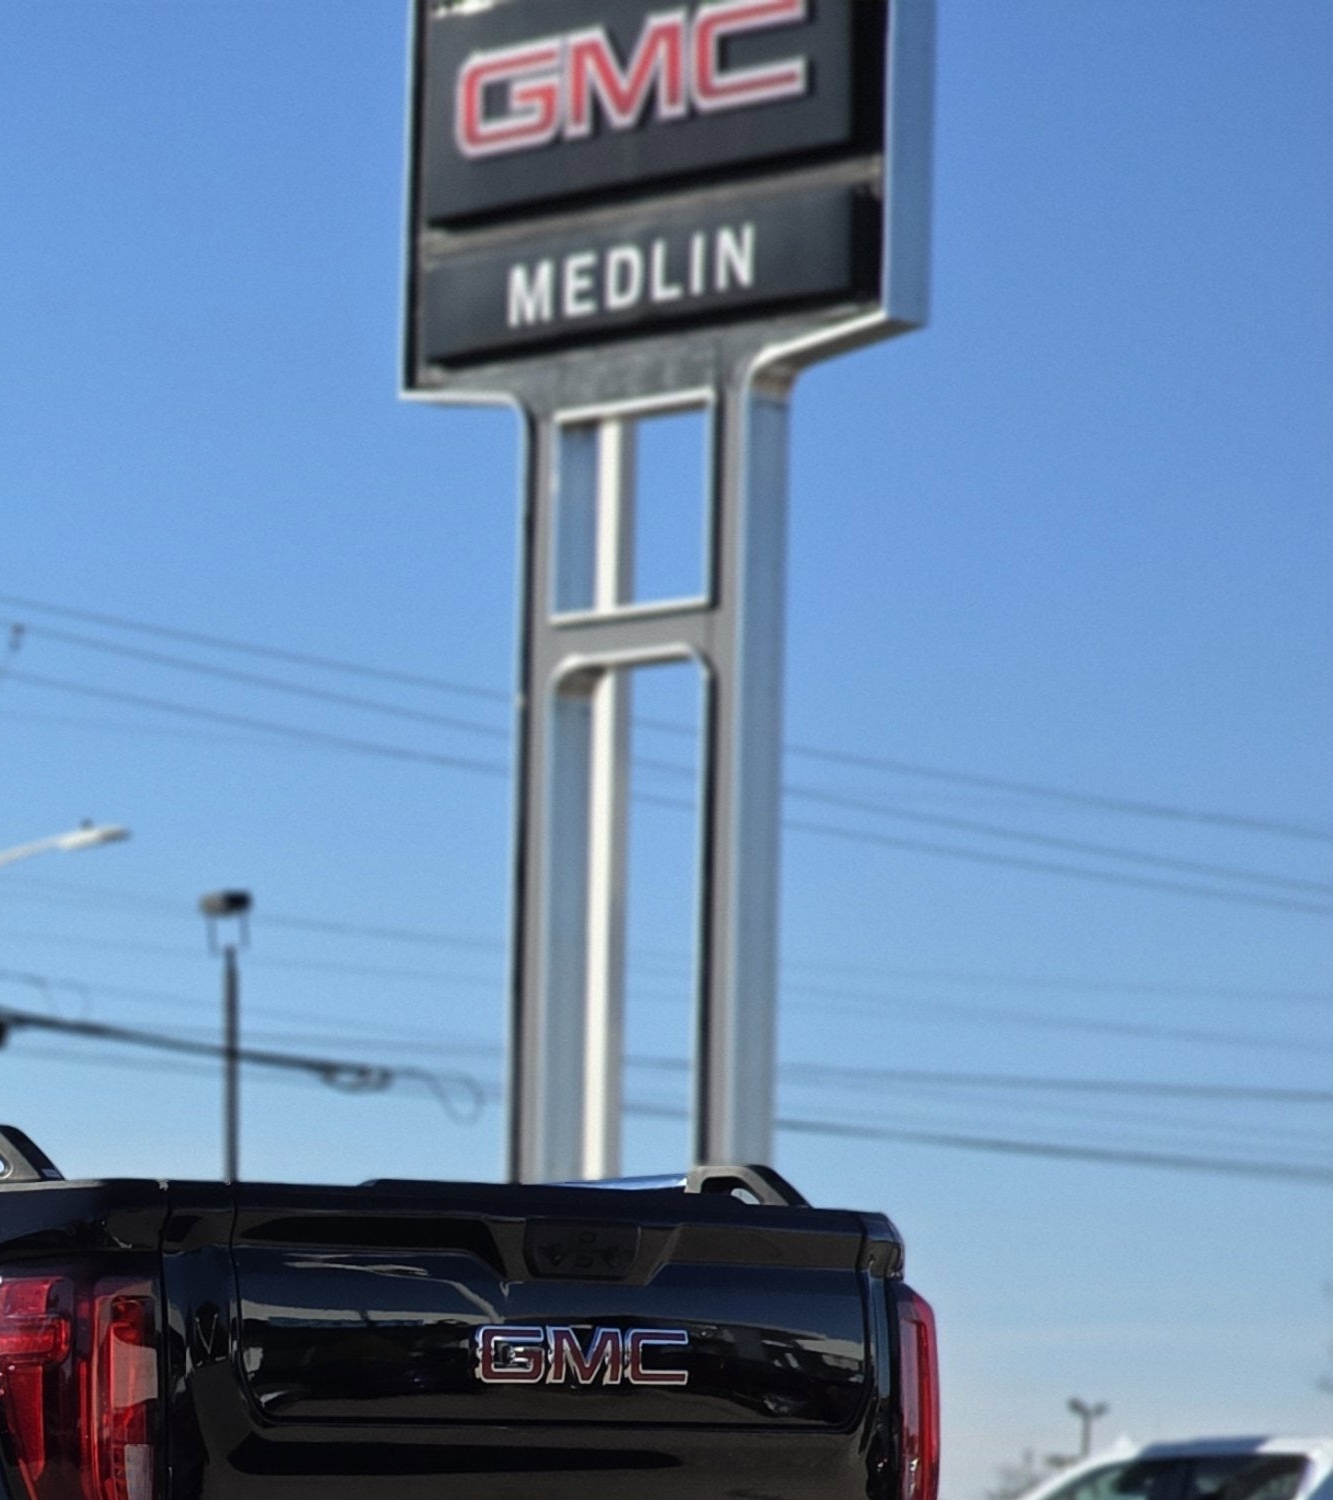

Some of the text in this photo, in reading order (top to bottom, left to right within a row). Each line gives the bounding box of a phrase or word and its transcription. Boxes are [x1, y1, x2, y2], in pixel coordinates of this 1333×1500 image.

[455, 0, 807, 158] GMC
[506, 222, 756, 328] MEDLIN
[474, 1324, 689, 1386] GMC
